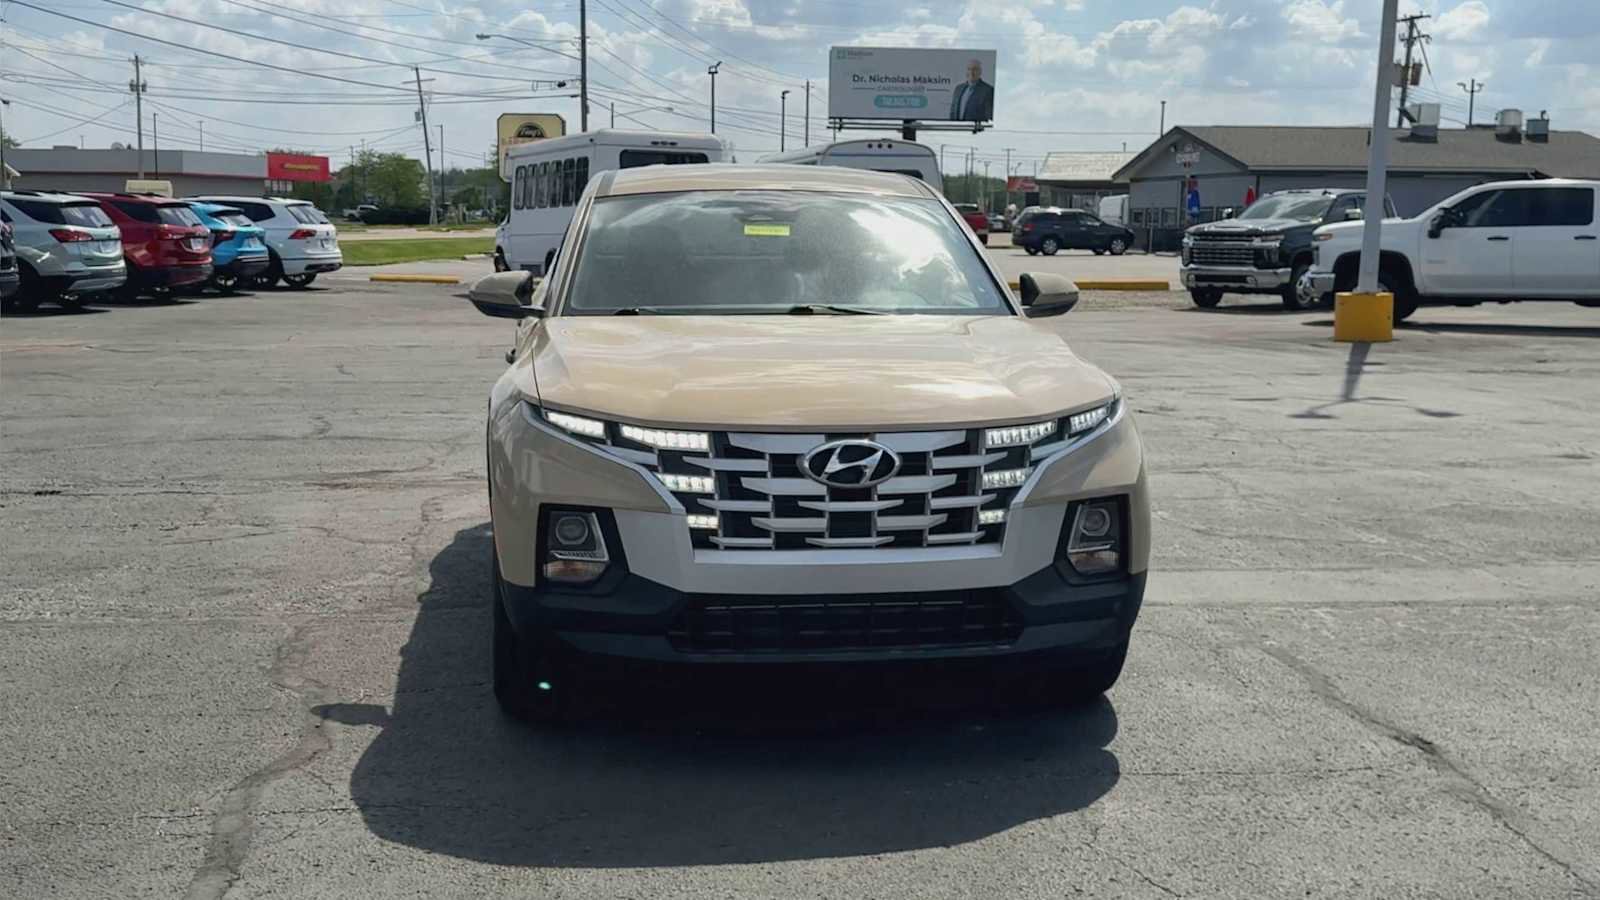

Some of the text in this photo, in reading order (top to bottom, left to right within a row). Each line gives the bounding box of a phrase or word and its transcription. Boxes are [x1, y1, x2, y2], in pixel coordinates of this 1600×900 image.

[852, 74, 951, 85] Dr. Nicholas Maksim
